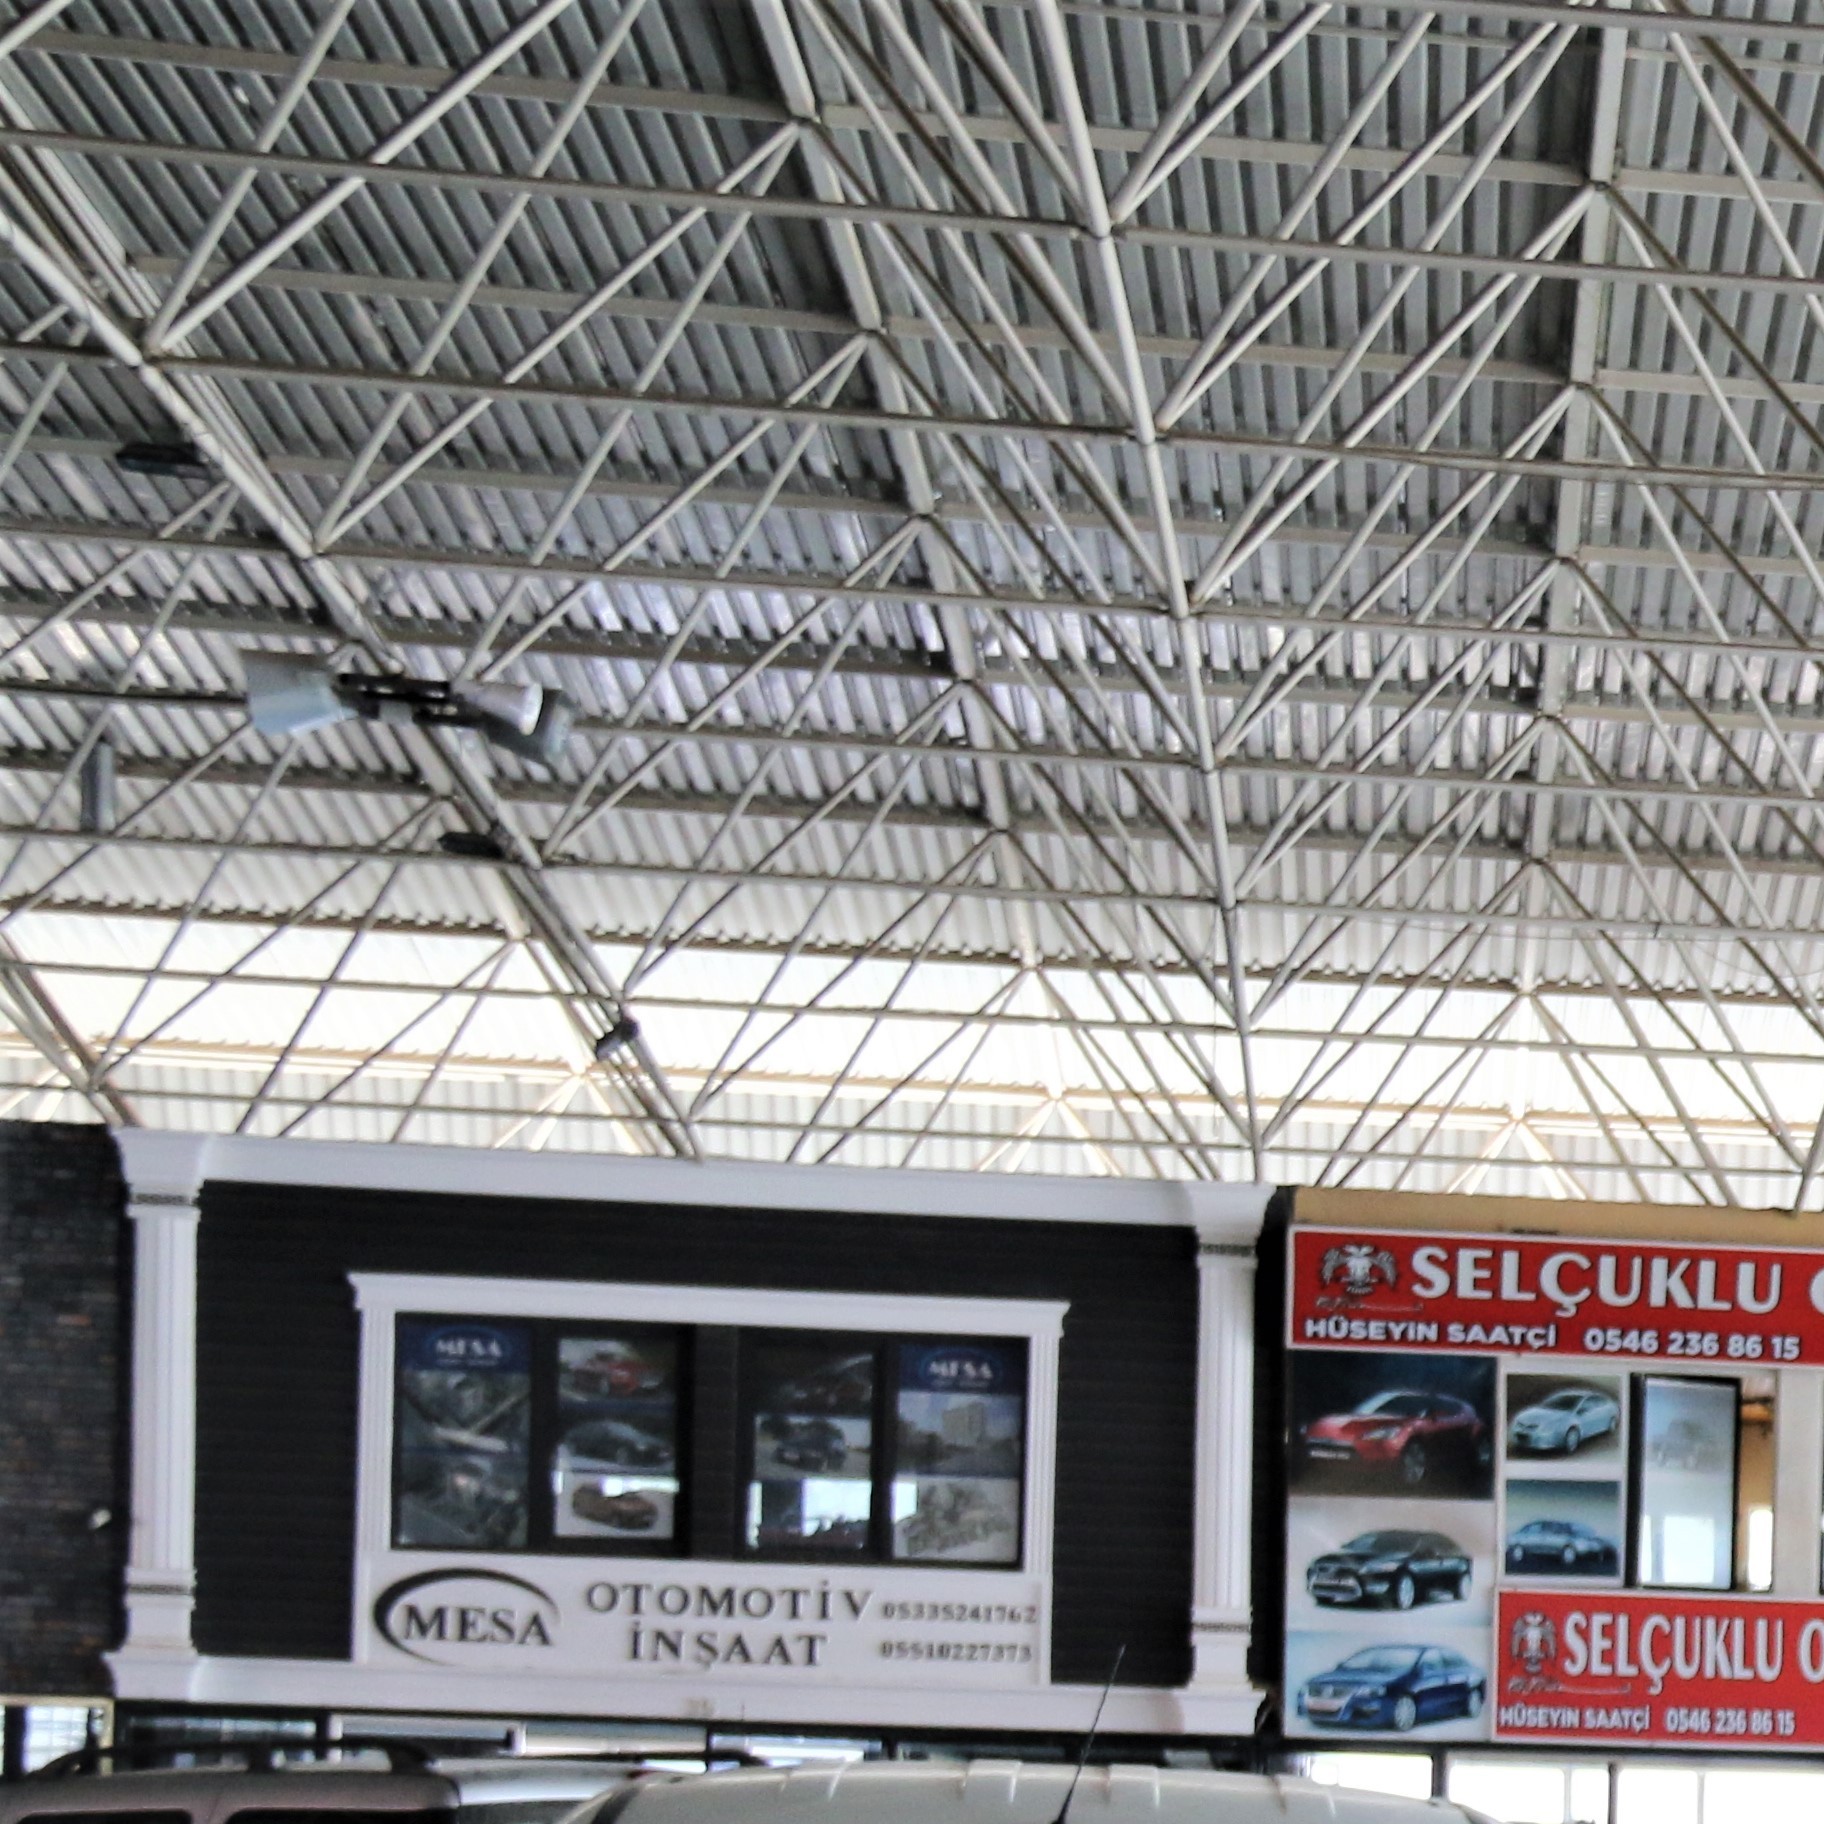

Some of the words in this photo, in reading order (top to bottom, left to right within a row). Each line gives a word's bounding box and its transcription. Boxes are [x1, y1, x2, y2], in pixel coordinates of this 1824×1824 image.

[1412, 1245, 1782, 1317] SELÇUKLU
[1583, 1328, 1658, 1355] 0546
[1667, 1331, 1719, 1357] 236
[1727, 1333, 1763, 1359] 86
[1771, 1335, 1800, 1360] 15
[586, 1580, 875, 1621] OTOMOTİV
[404, 1602, 553, 1647] MESA
[631, 1621, 827, 1670] İNŞAAT
[1563, 1611, 1784, 1696] SELÇUKLU
[1665, 1706, 1711, 1734] 0546
[1714, 1708, 1748, 1735] 236
[1751, 1709, 1772, 1736] 86
[1775, 1710, 1796, 1736] 15
